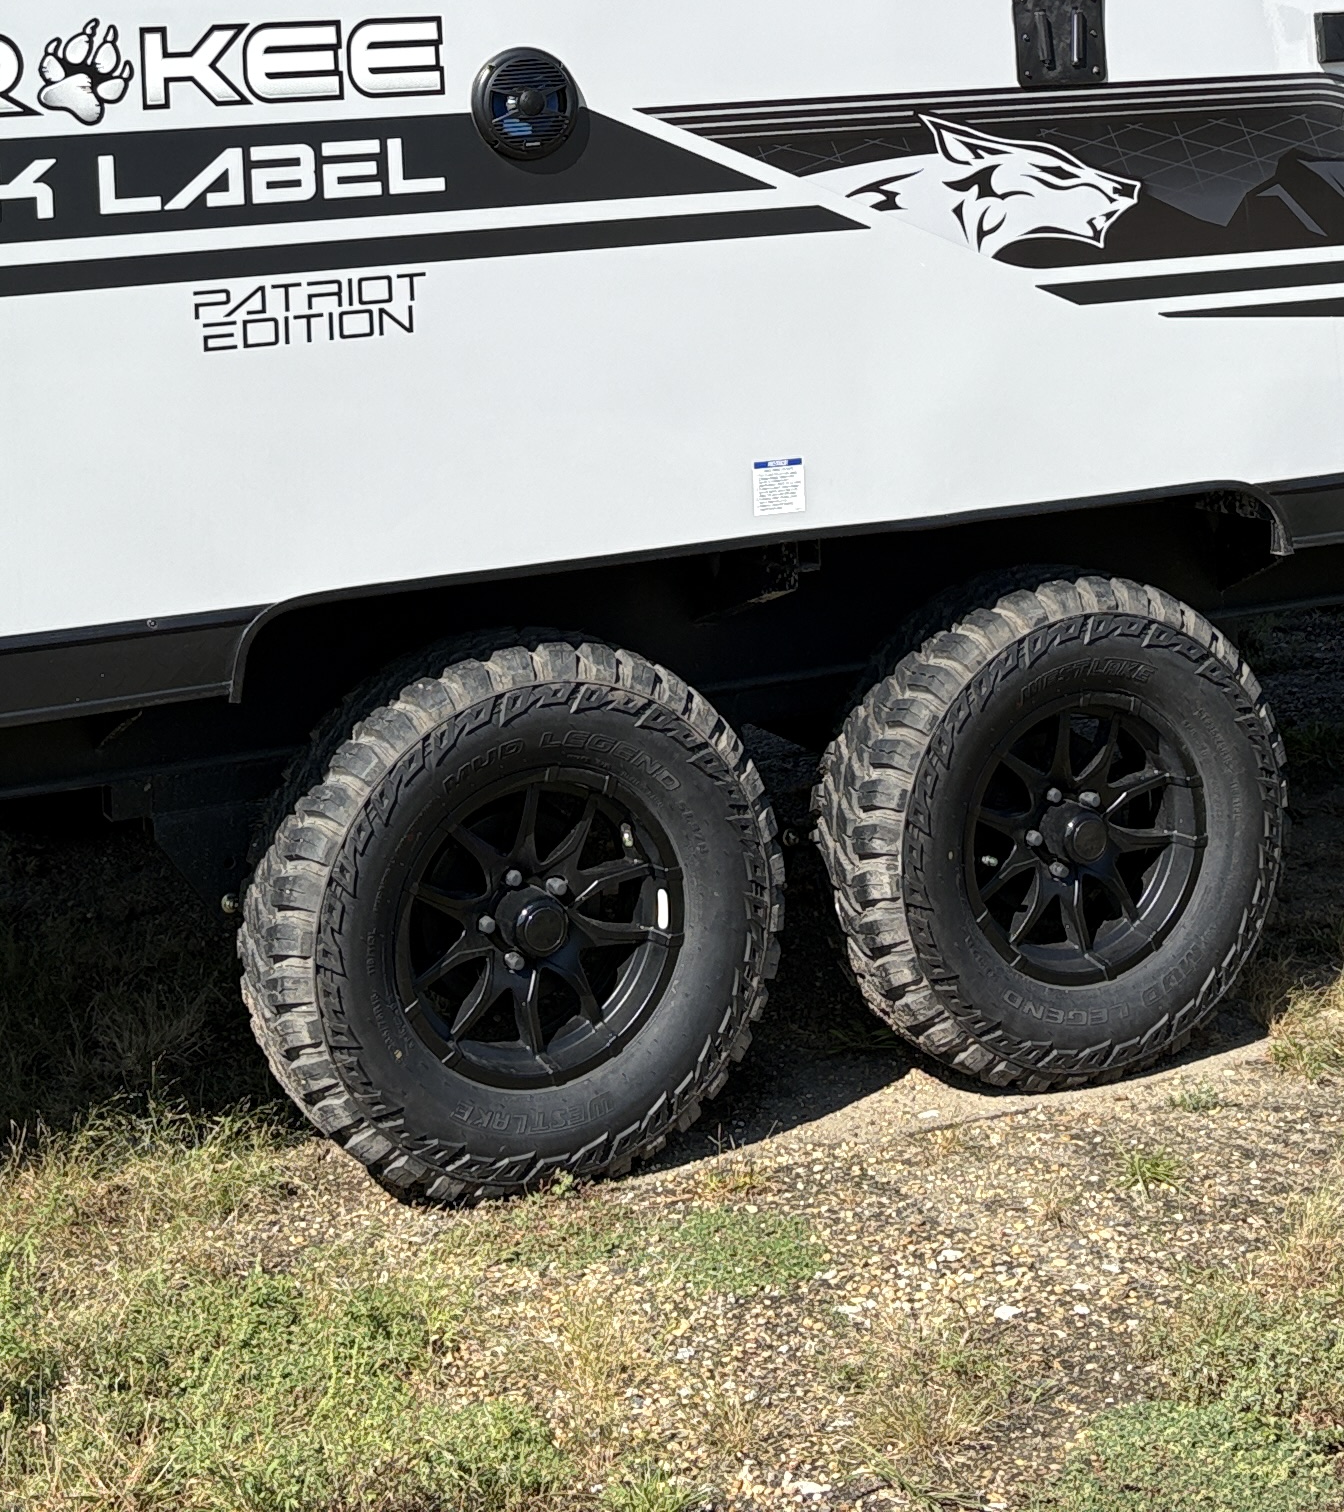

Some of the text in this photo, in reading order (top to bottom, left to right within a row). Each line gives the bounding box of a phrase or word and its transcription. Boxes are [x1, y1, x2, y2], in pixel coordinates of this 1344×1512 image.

[96, 137, 446, 216] LABEL
[192, 272, 427, 321] PATRIOT
[202, 305, 415, 353] EDITION
[1019, 655, 1159, 708] WESTLAKE
[441, 737, 525, 794] MUD
[538, 729, 682, 792] LEGEND
[1001, 944, 1205, 1027] MUD LEGEND
[449, 1091, 617, 1136] WESTLAKE
